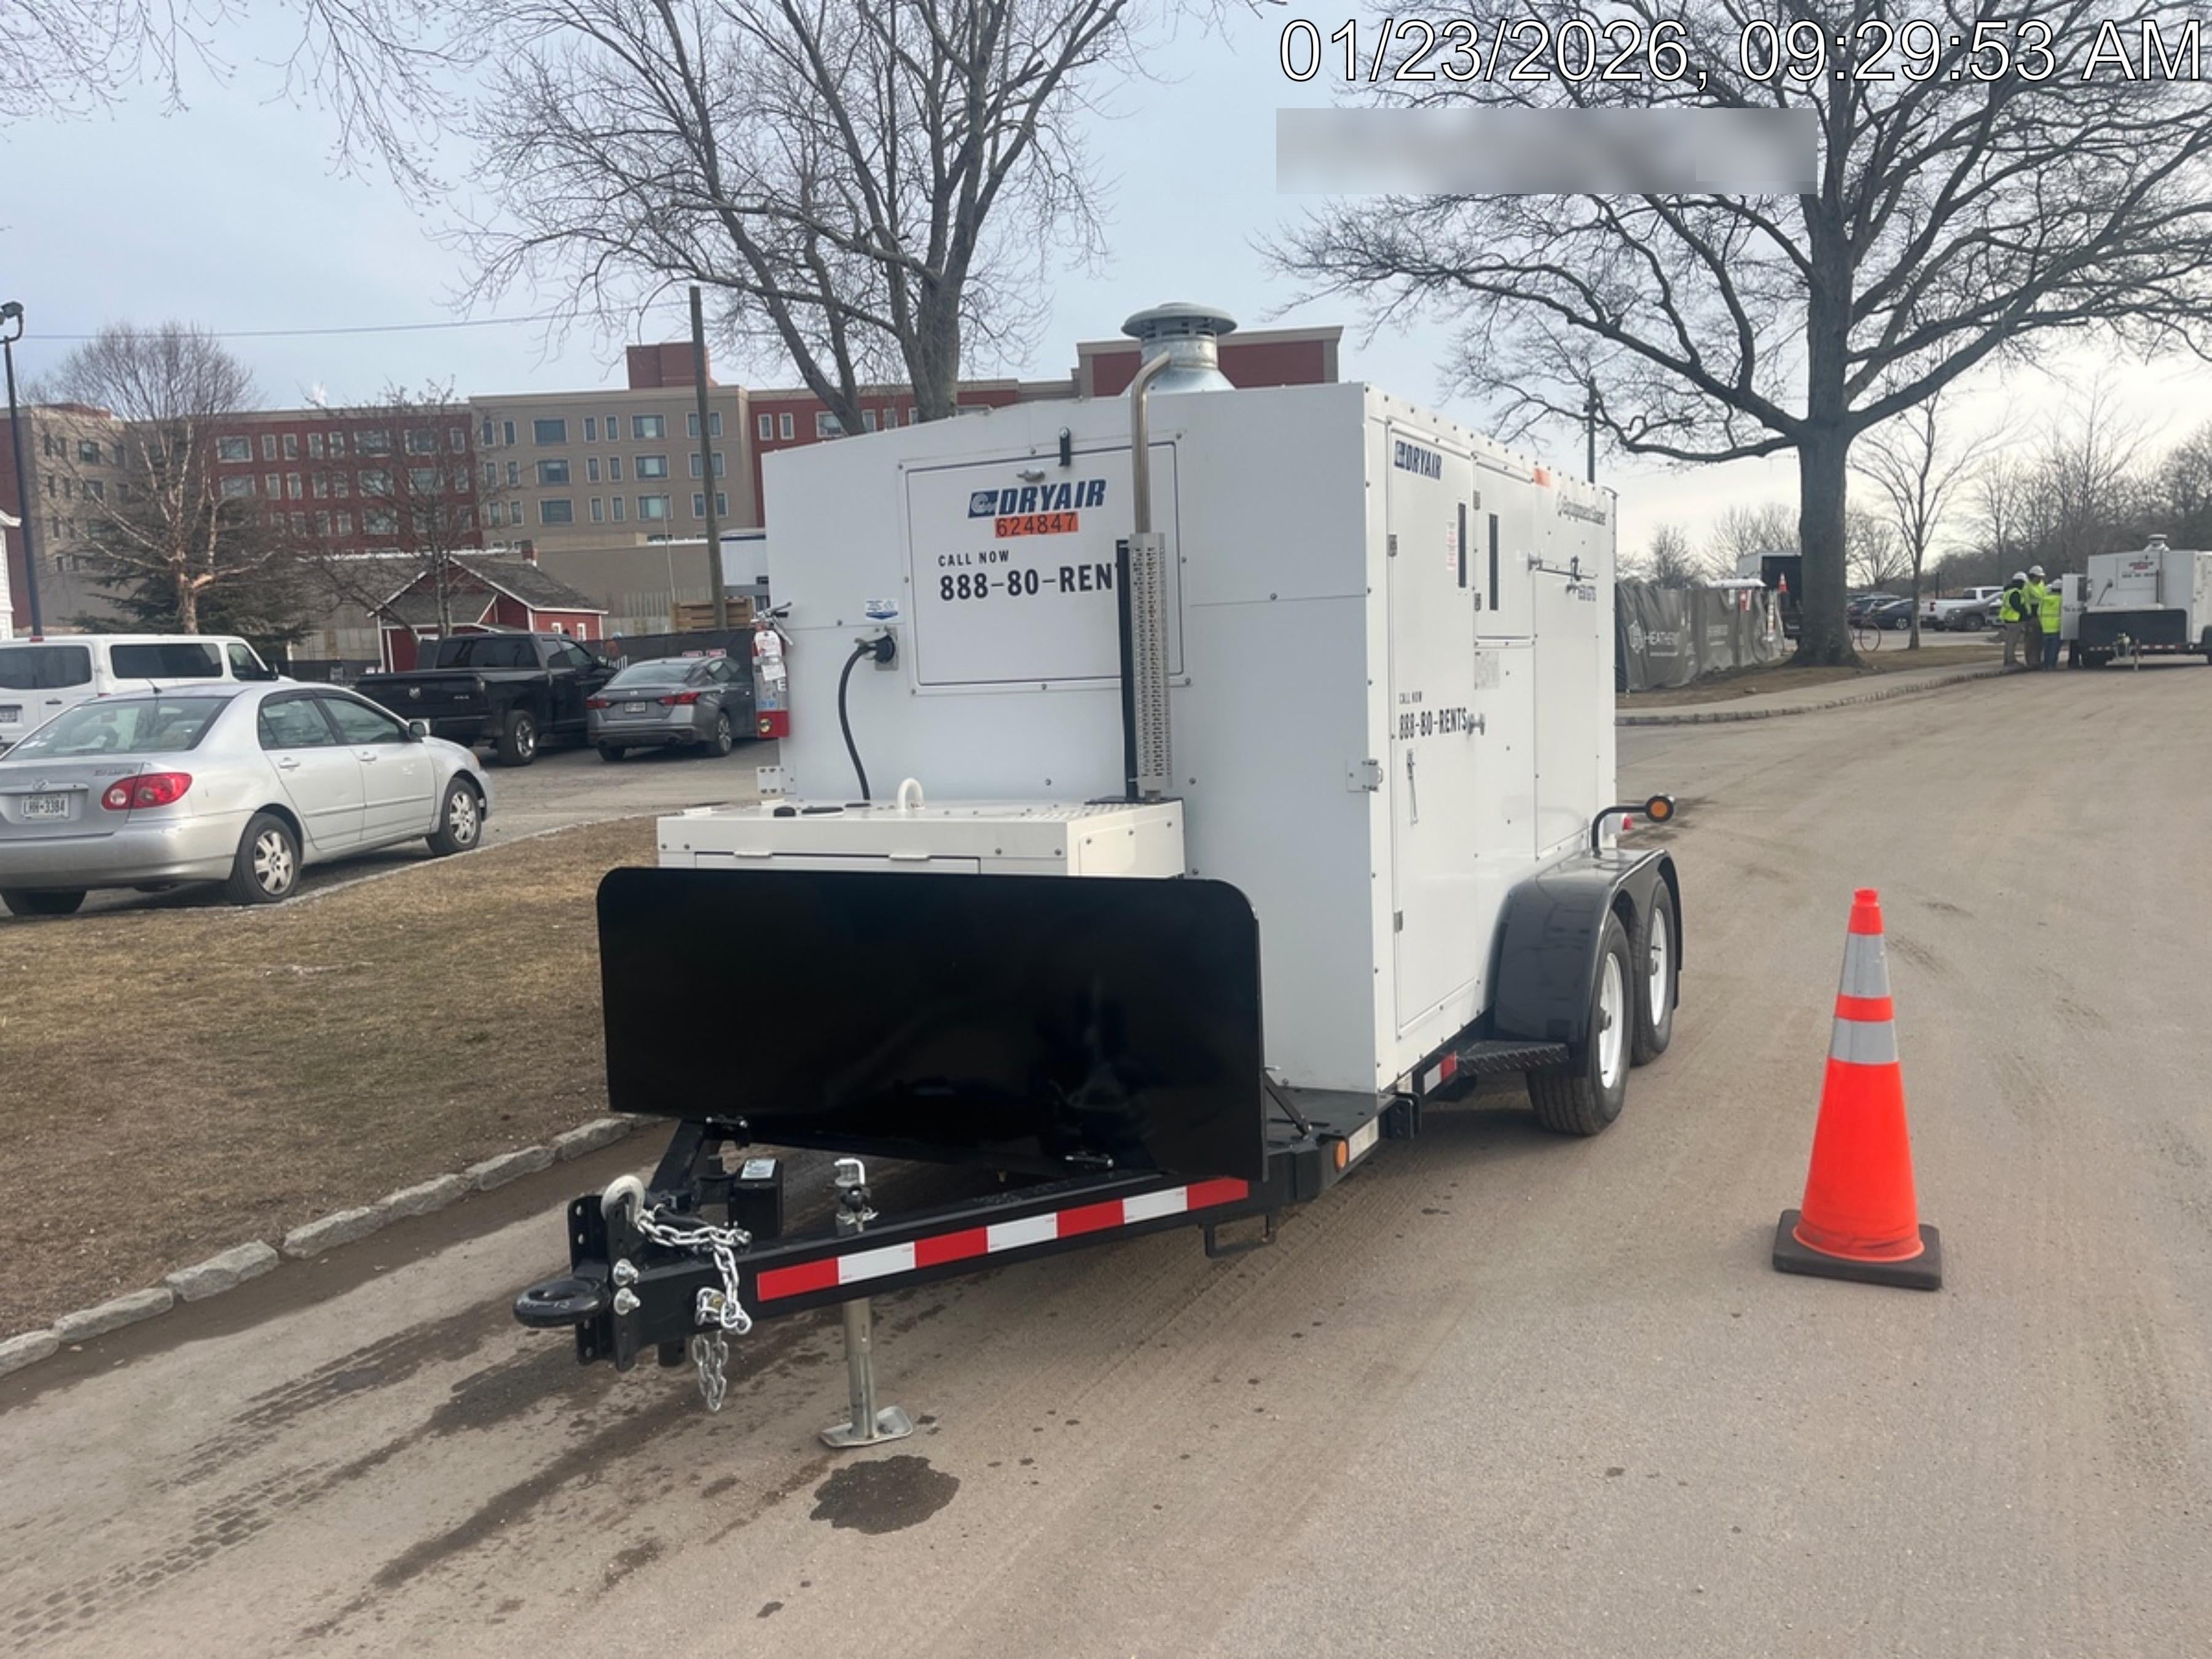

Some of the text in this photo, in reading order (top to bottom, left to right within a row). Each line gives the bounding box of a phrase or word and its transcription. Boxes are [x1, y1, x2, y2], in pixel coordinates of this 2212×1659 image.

[1406, 441, 1441, 480] DRYAIR
[999, 479, 1107, 515] DRYAIR
[996, 512, 1078, 537] 624847
[938, 550, 1010, 567] CALL NOW
[940, 563, 1117, 601] 888-80-REN
[1400, 691, 1422, 704] CALL NOW
[1400, 707, 1467, 740] 888-80-RENTS
